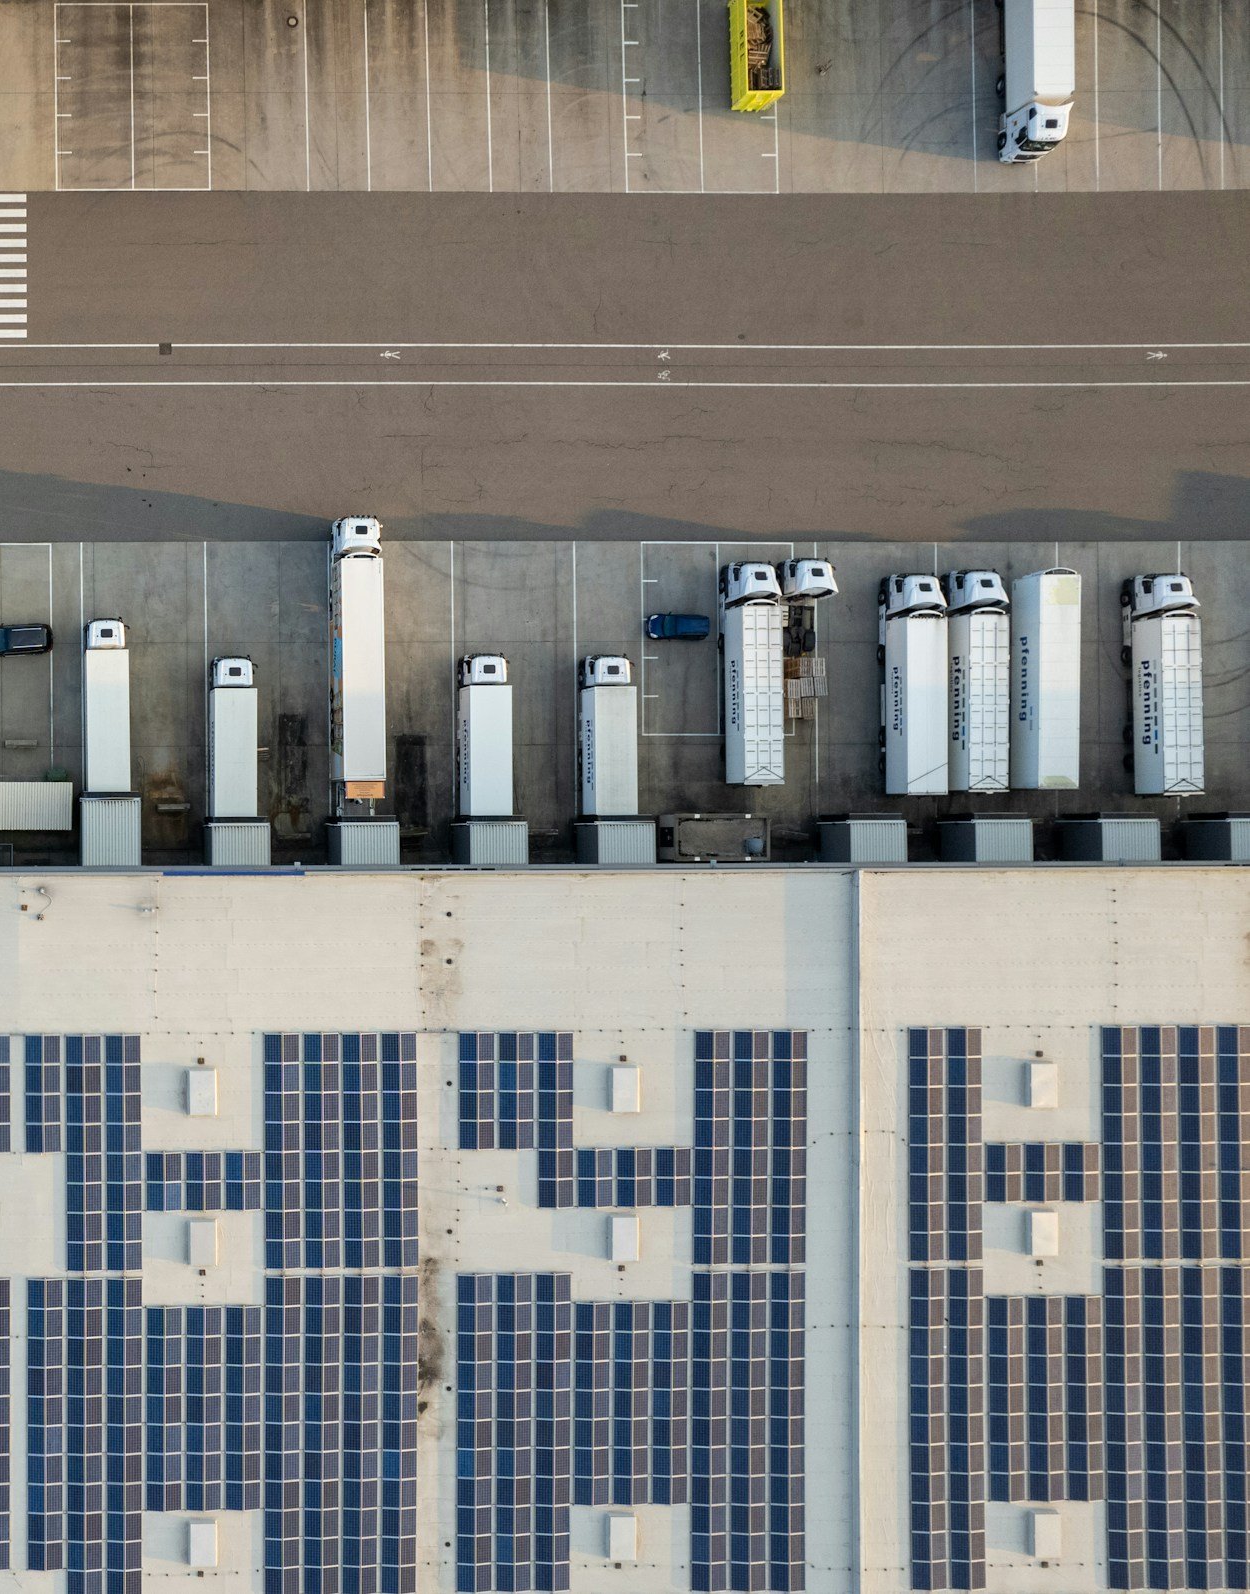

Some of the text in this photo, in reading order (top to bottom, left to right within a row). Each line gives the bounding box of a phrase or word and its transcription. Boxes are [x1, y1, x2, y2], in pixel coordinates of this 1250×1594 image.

[892, 666, 900, 731] pfenning
[952, 655, 962, 741] pfenning
[1018, 636, 1030, 722] pfenning
[1140, 660, 1153, 745] pfenning
